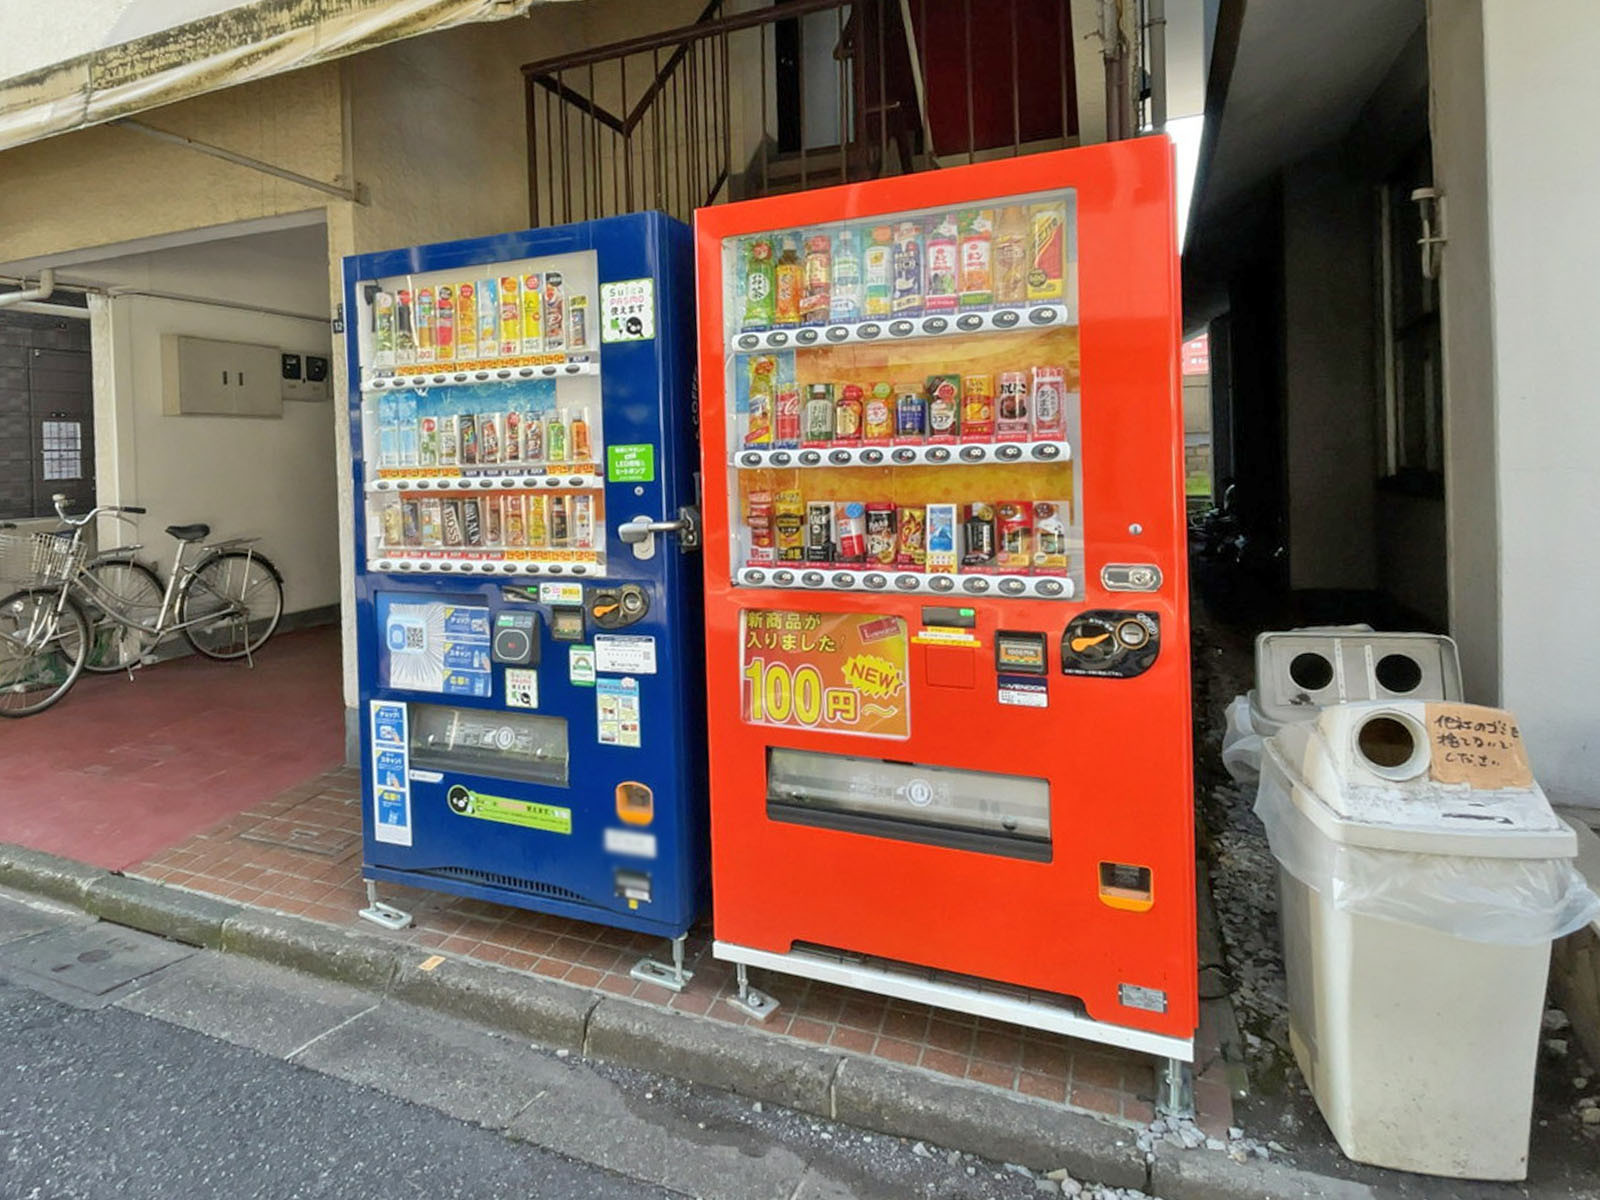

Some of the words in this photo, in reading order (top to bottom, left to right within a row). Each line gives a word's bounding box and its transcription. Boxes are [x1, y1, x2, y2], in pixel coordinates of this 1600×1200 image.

[610, 304, 645, 316] 使えます
[748, 612, 822, 630] 新商品が
[747, 633, 837, 652] 入りました
[1434, 714, 1520, 738] 他社のゴミを
